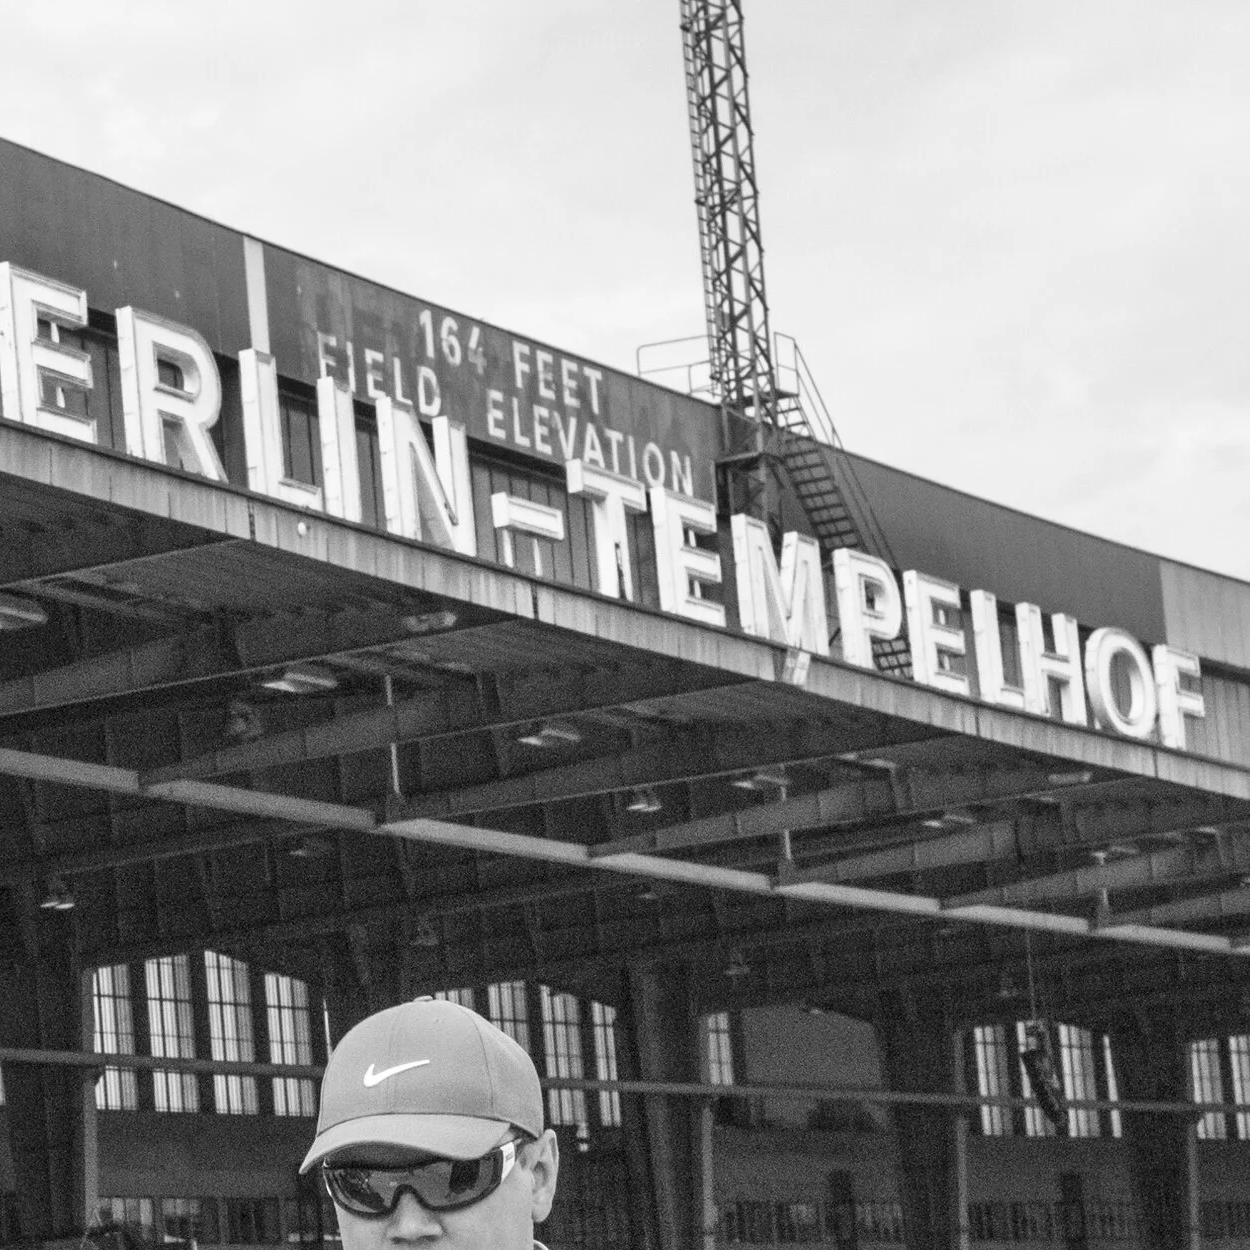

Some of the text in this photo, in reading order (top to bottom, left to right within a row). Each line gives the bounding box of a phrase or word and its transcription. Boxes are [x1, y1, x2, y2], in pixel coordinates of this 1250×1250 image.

[318, 331, 692, 497] FIELD ELEVATION
[419, 309, 603, 415] 164 FEET
